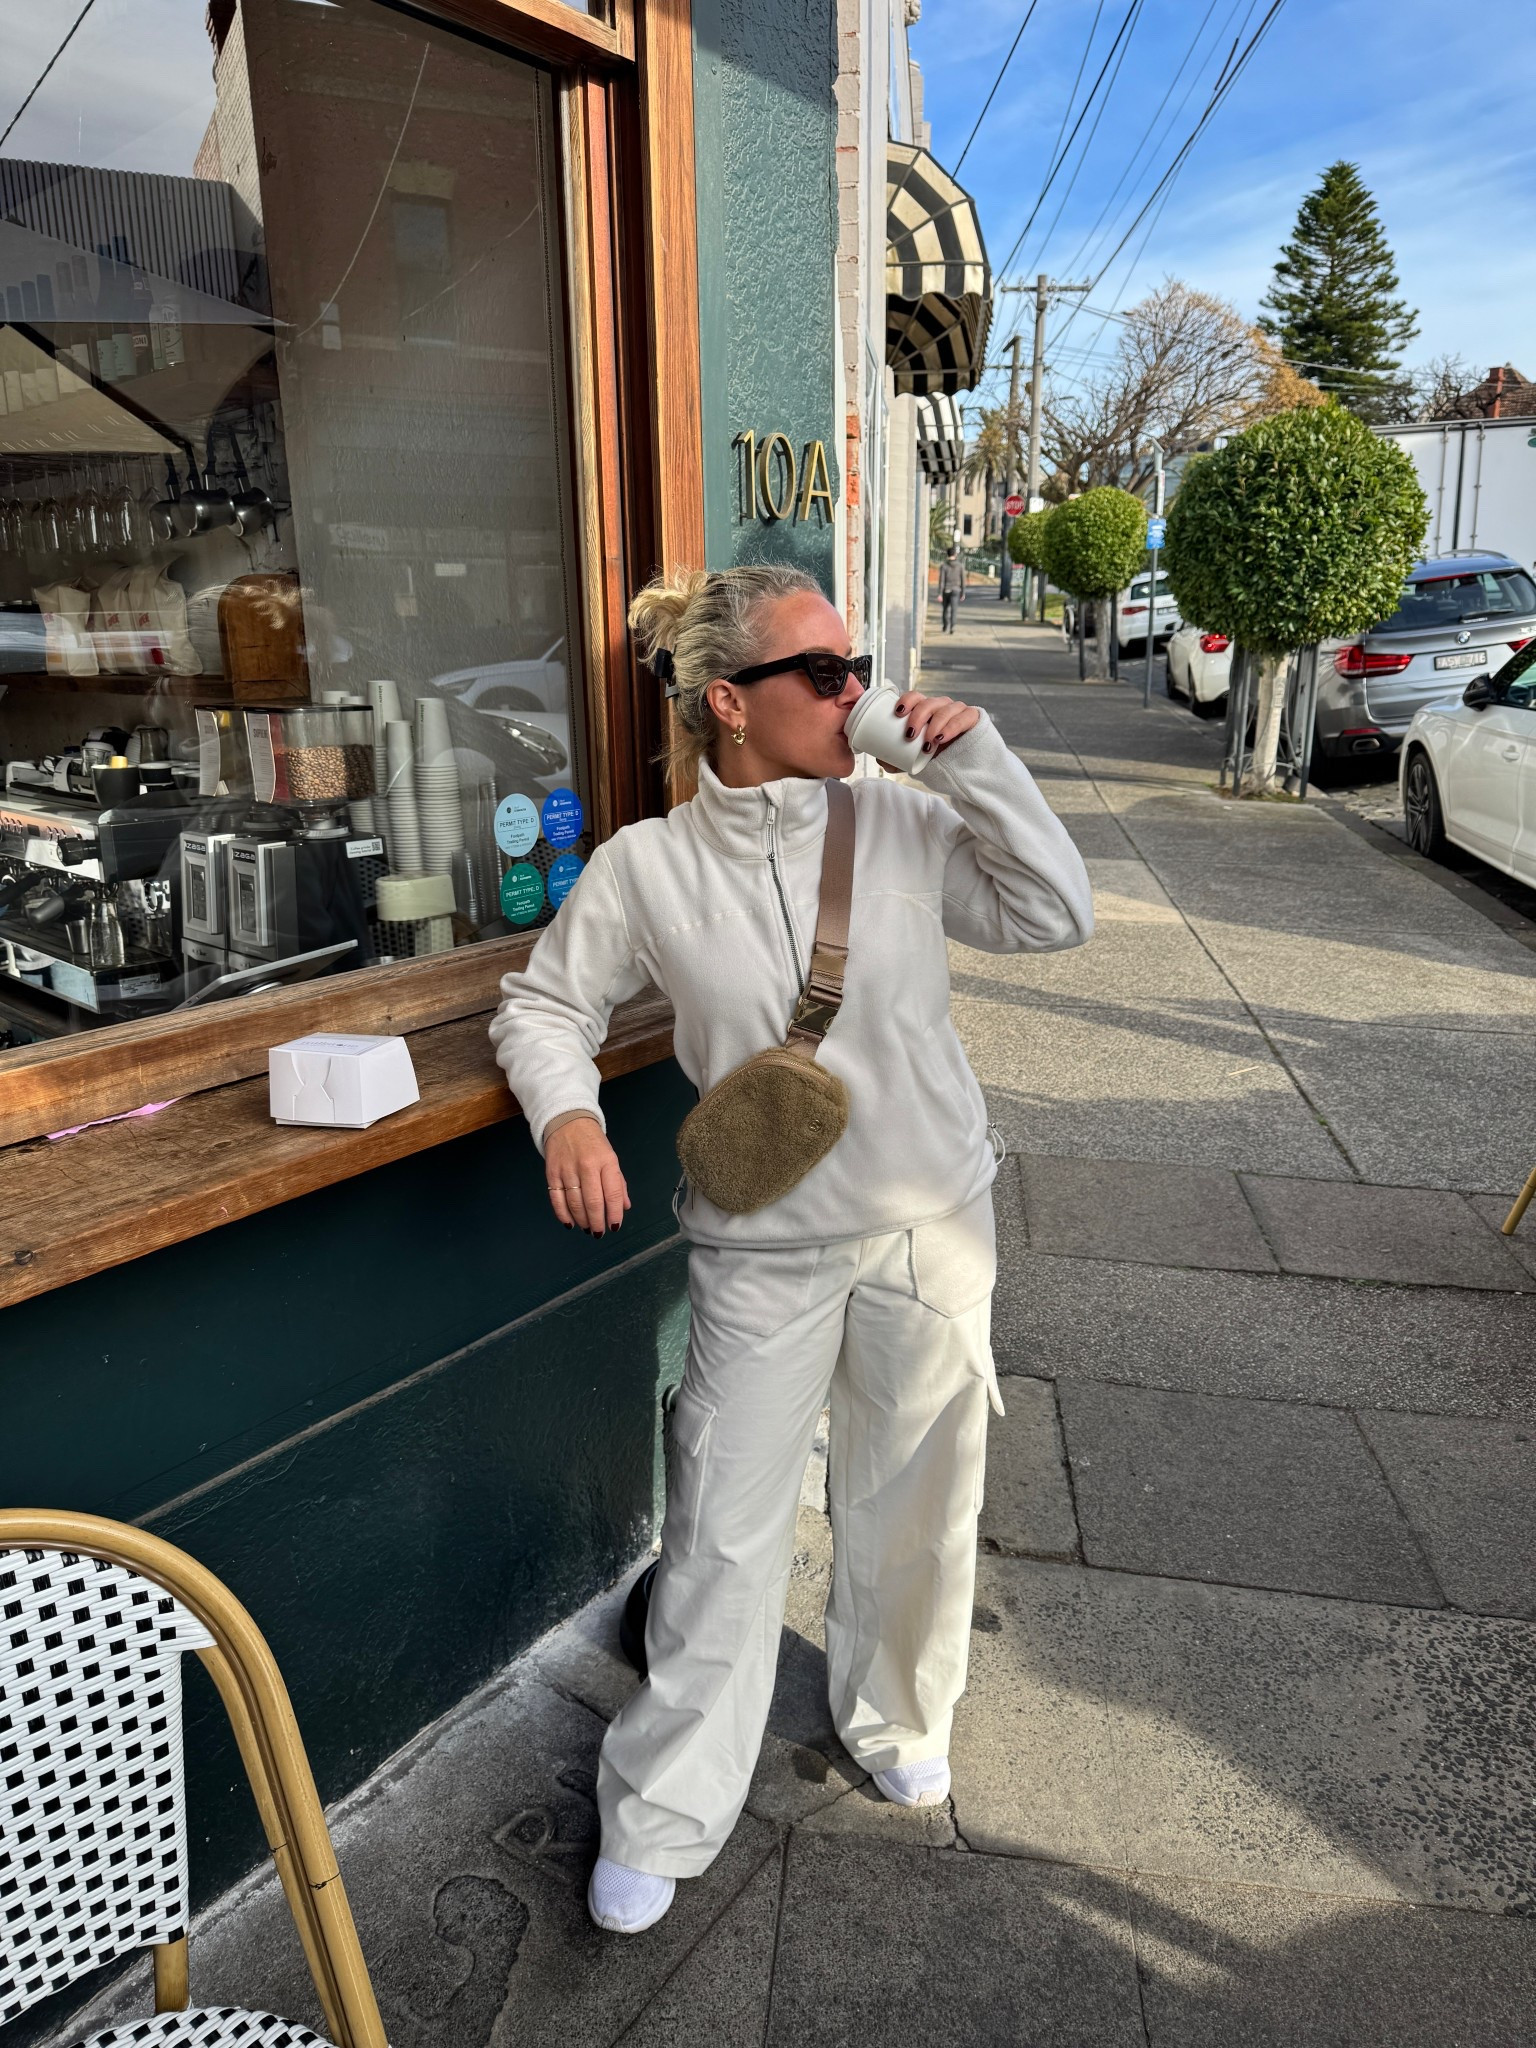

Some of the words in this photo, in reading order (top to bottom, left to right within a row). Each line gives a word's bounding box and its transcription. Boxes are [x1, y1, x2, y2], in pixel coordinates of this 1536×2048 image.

[736, 428, 835, 523] 10A
[1006, 501, 1024, 510] STOP
[499, 820, 516, 828] PERMIT
